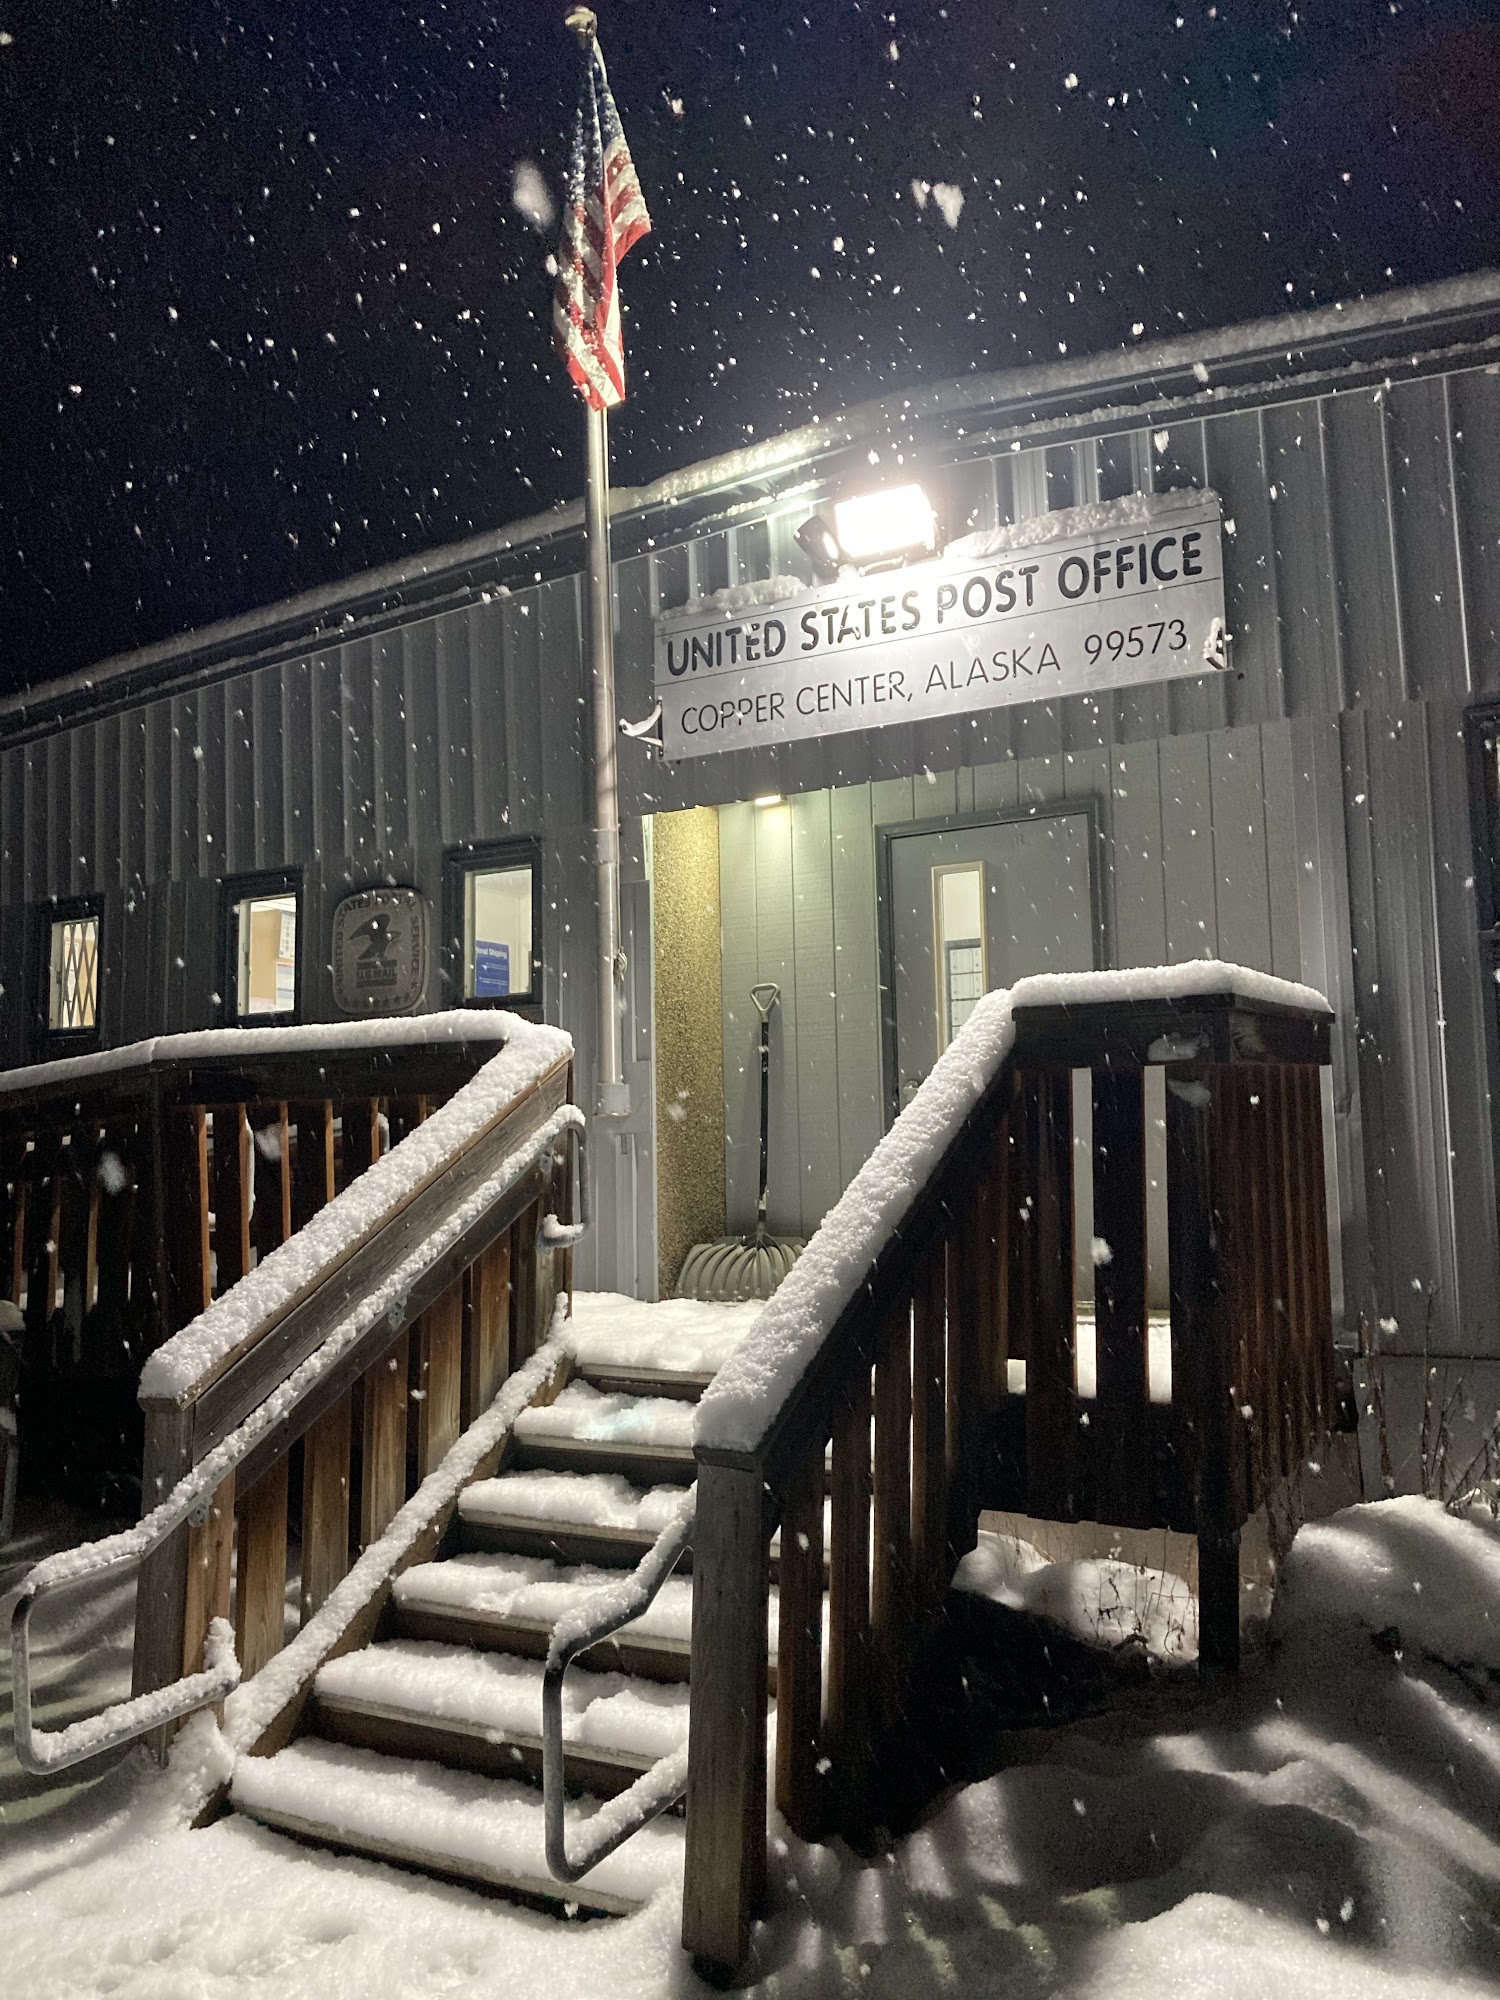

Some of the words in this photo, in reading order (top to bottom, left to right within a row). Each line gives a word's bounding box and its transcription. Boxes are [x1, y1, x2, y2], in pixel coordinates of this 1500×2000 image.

[668, 618, 787, 676] UNITED
[800, 590, 921, 651] STATES
[936, 564, 1040, 624] POST
[1057, 532, 1203, 599] OFFICE
[681, 691, 786, 735] COPPER
[796, 670, 913, 716] CENTER,
[925, 642, 1062, 694] ALASKA
[1083, 618, 1188, 666] 99573
[410, 915, 420, 976] SERVICE
